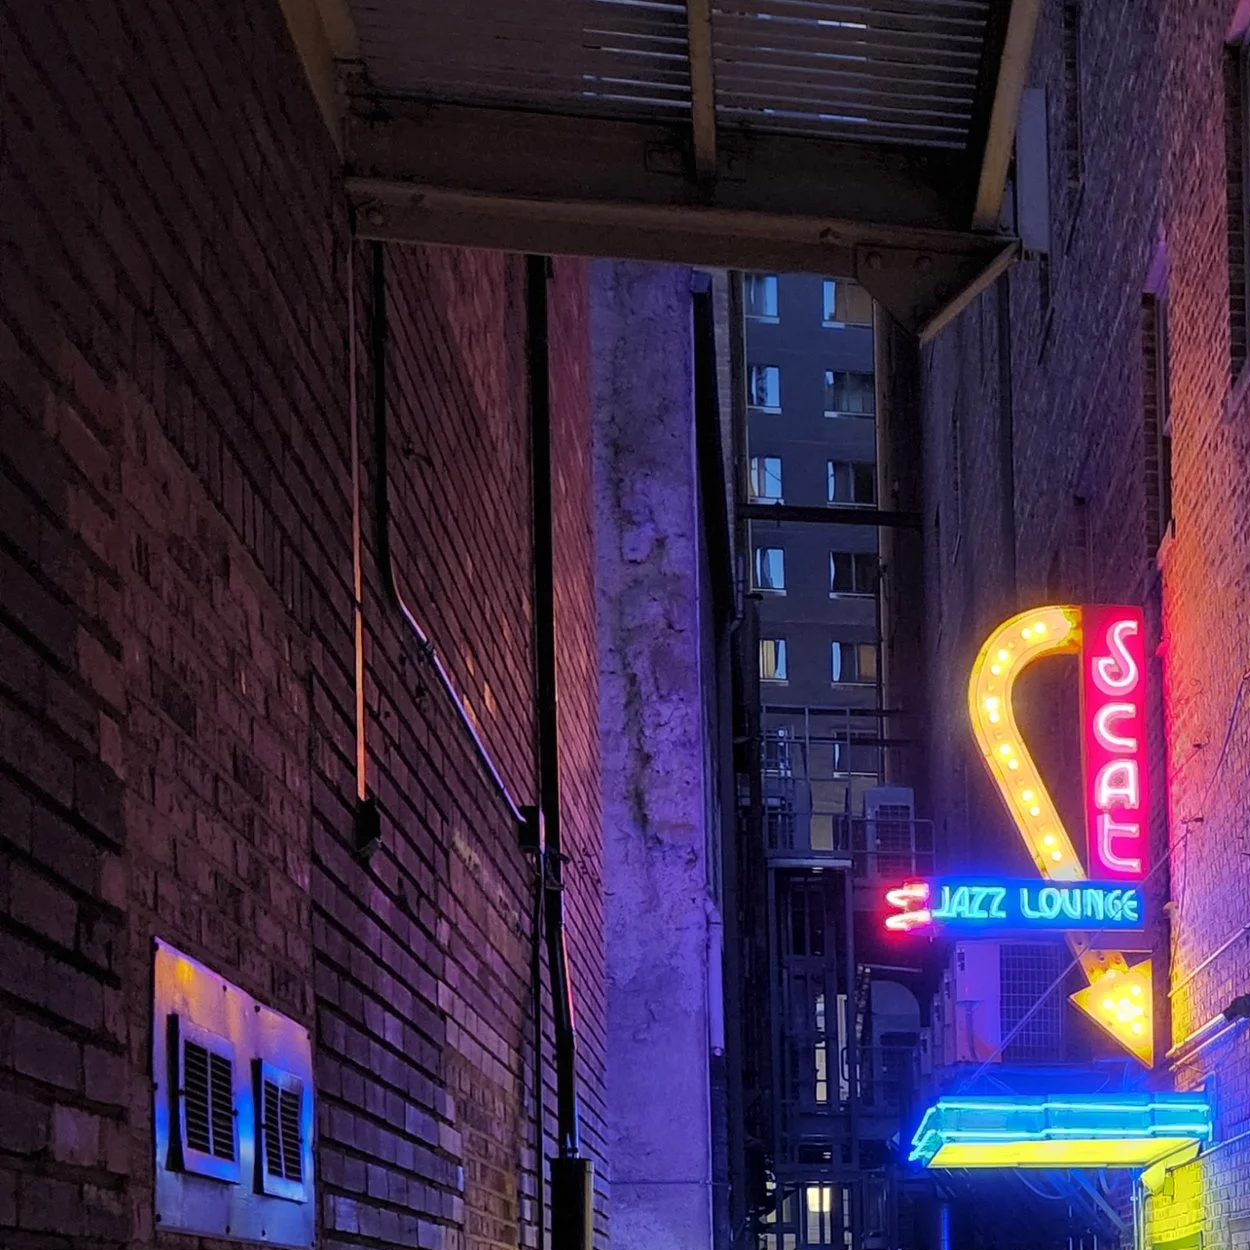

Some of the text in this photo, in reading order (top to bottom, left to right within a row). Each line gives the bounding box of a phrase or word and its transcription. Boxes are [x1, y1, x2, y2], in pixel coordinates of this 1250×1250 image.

[1091, 620, 1142, 873] SCAT
[931, 886, 1139, 921] JAZZ LOUNGE
